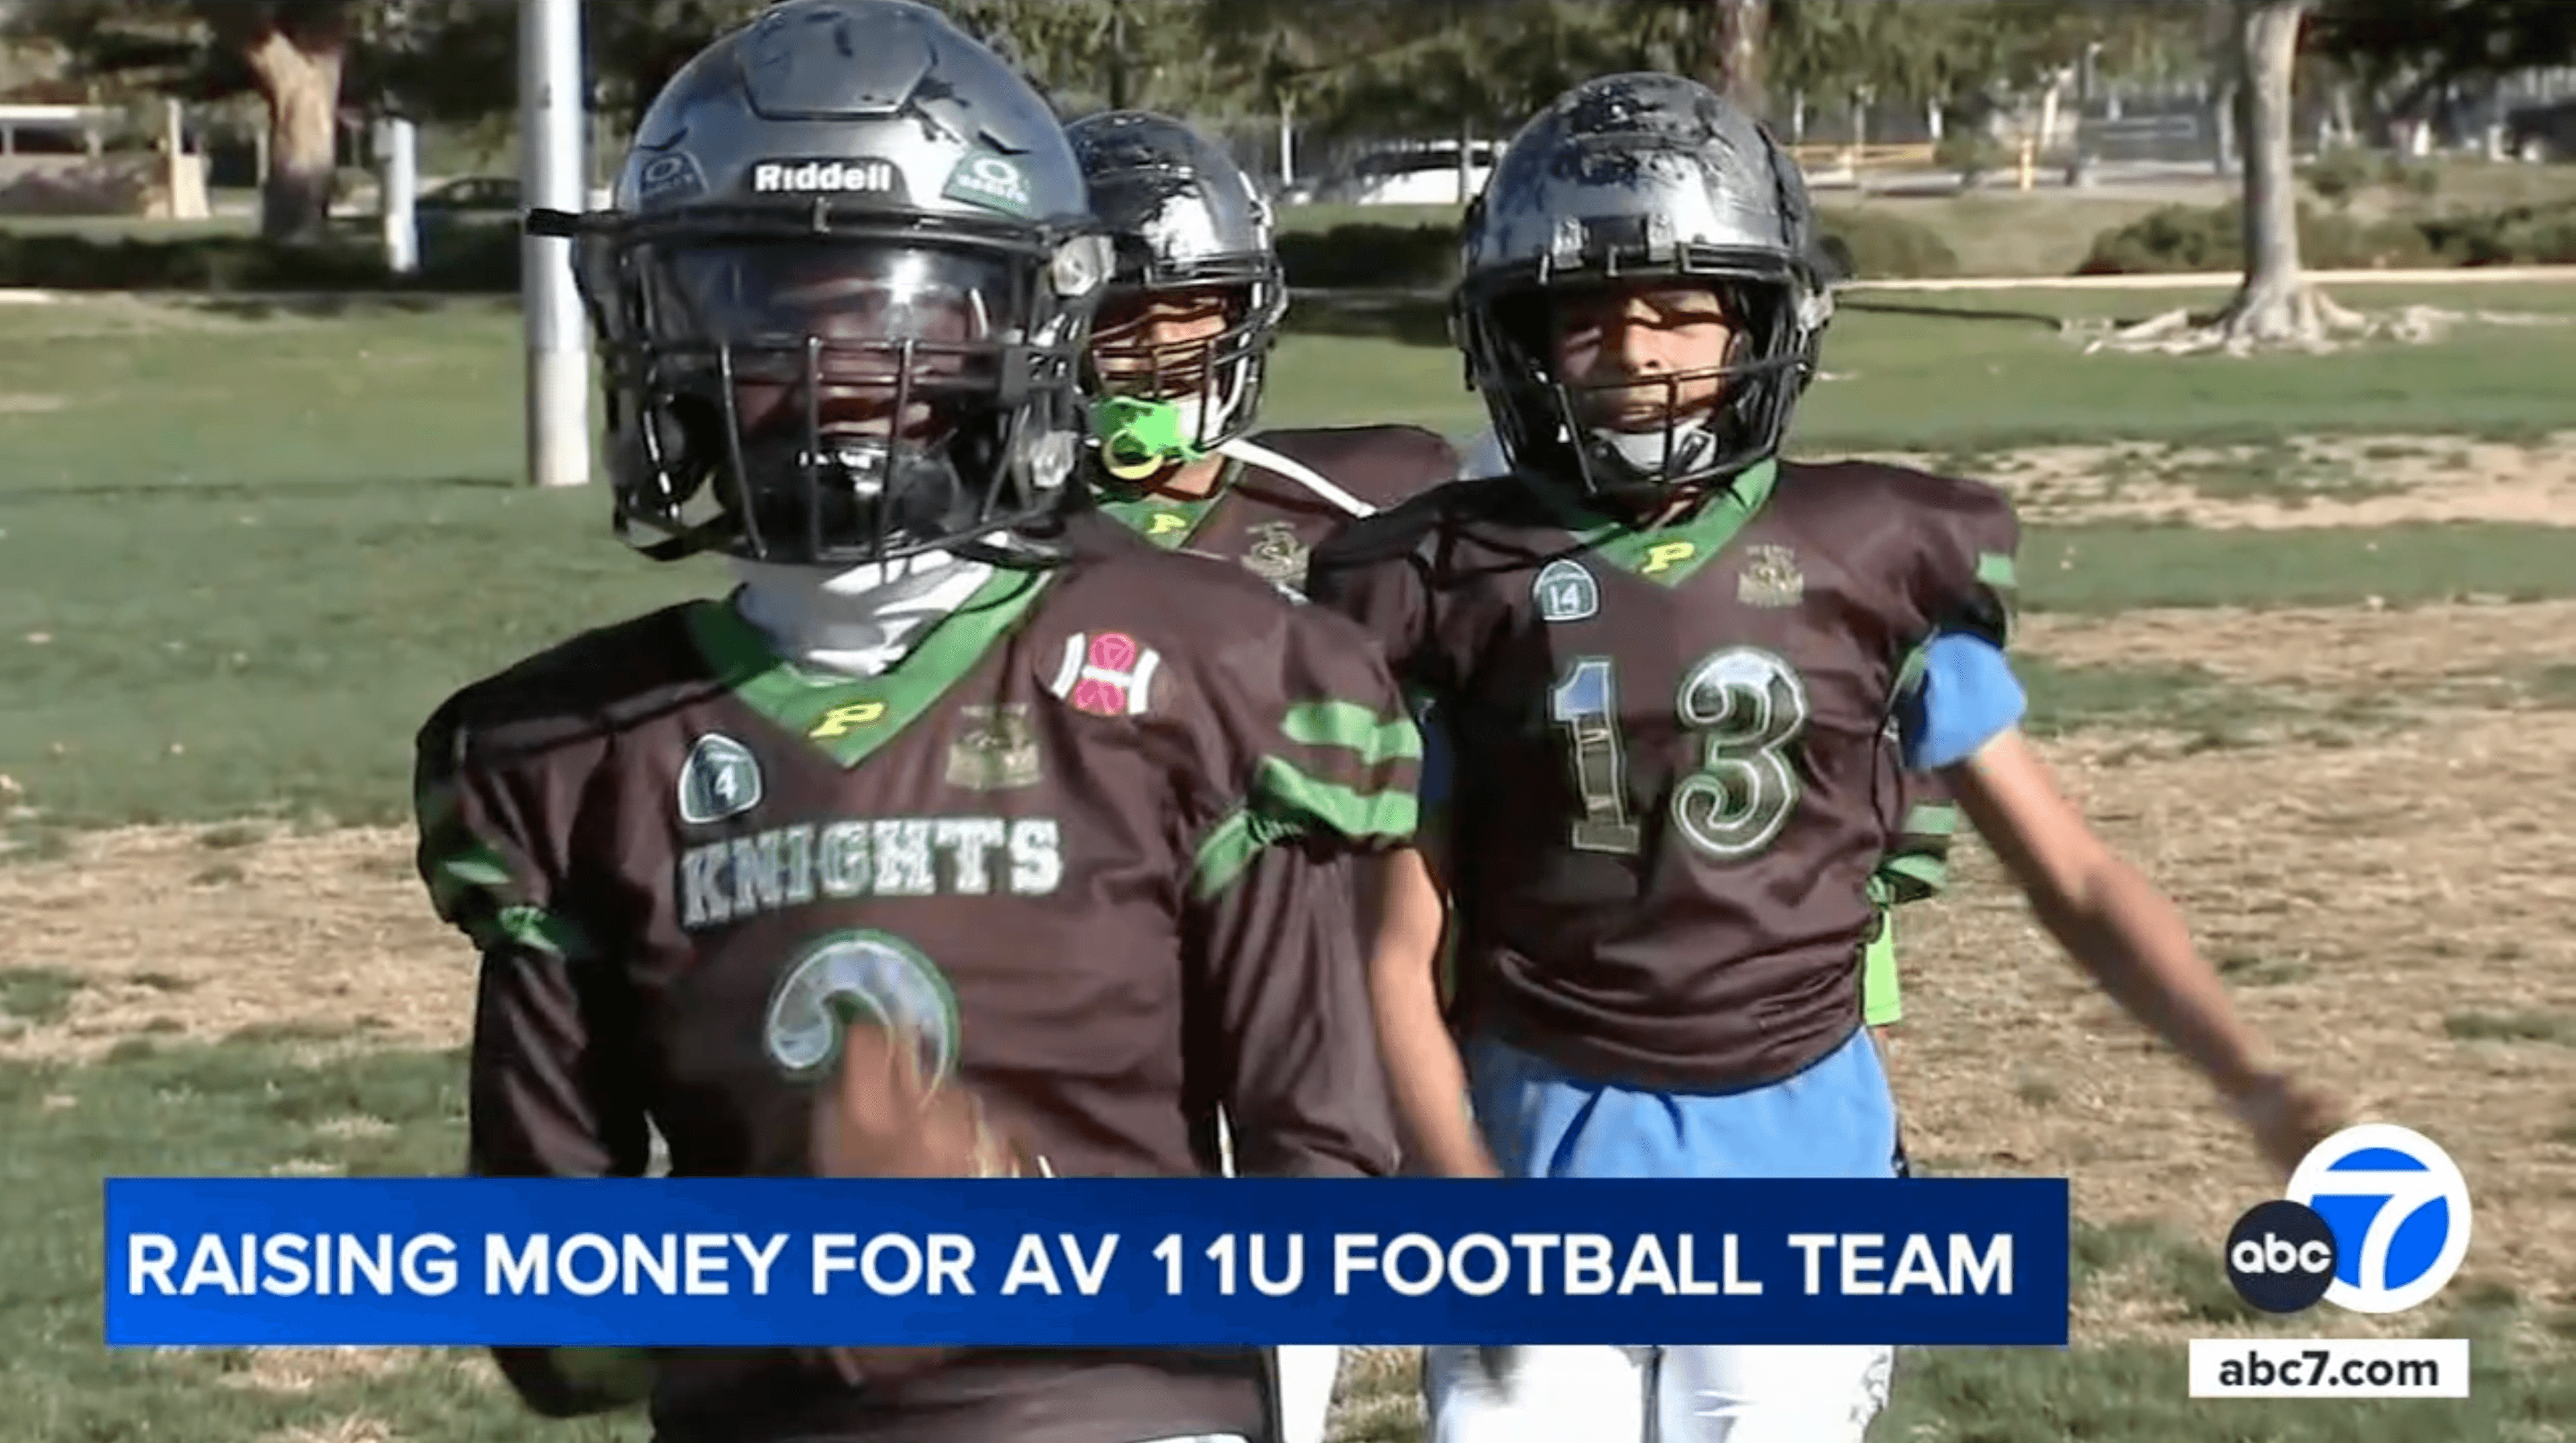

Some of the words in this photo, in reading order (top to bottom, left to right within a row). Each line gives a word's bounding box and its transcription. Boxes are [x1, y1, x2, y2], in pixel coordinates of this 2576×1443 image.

[755, 163, 891, 191] Riddell
[1642, 542, 1695, 574] P
[1550, 582, 1581, 614] 14
[809, 700, 887, 739] P
[1549, 648, 1806, 858] 13
[680, 816, 1064, 928] KNIGHTS
